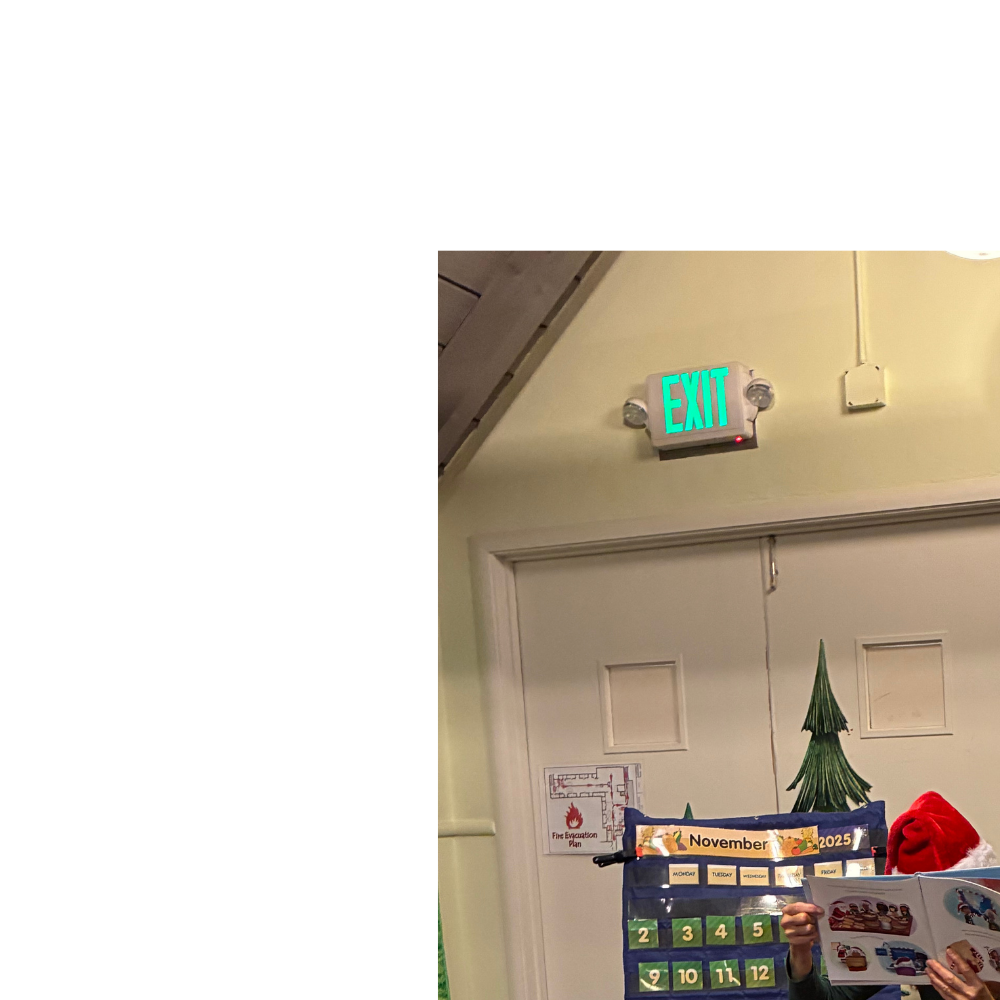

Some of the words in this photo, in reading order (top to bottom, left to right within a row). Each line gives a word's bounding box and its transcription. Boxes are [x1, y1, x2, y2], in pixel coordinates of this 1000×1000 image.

[661, 367, 729, 434] EXIT
[552, 831, 564, 840] Fire
[564, 831, 598, 841] Evacuation
[568, 839, 582, 848] Plan
[689, 833, 769, 851] November
[819, 832, 852, 849] 2025
[638, 927, 650, 943] 2
[682, 925, 694, 942] 3
[714, 923, 728, 939] 4
[752, 921, 764, 938] 5
[649, 968, 660, 985] 9
[678, 968, 698, 985] 10
[715, 967, 735, 984] 11
[750, 965, 770, 981] 12
